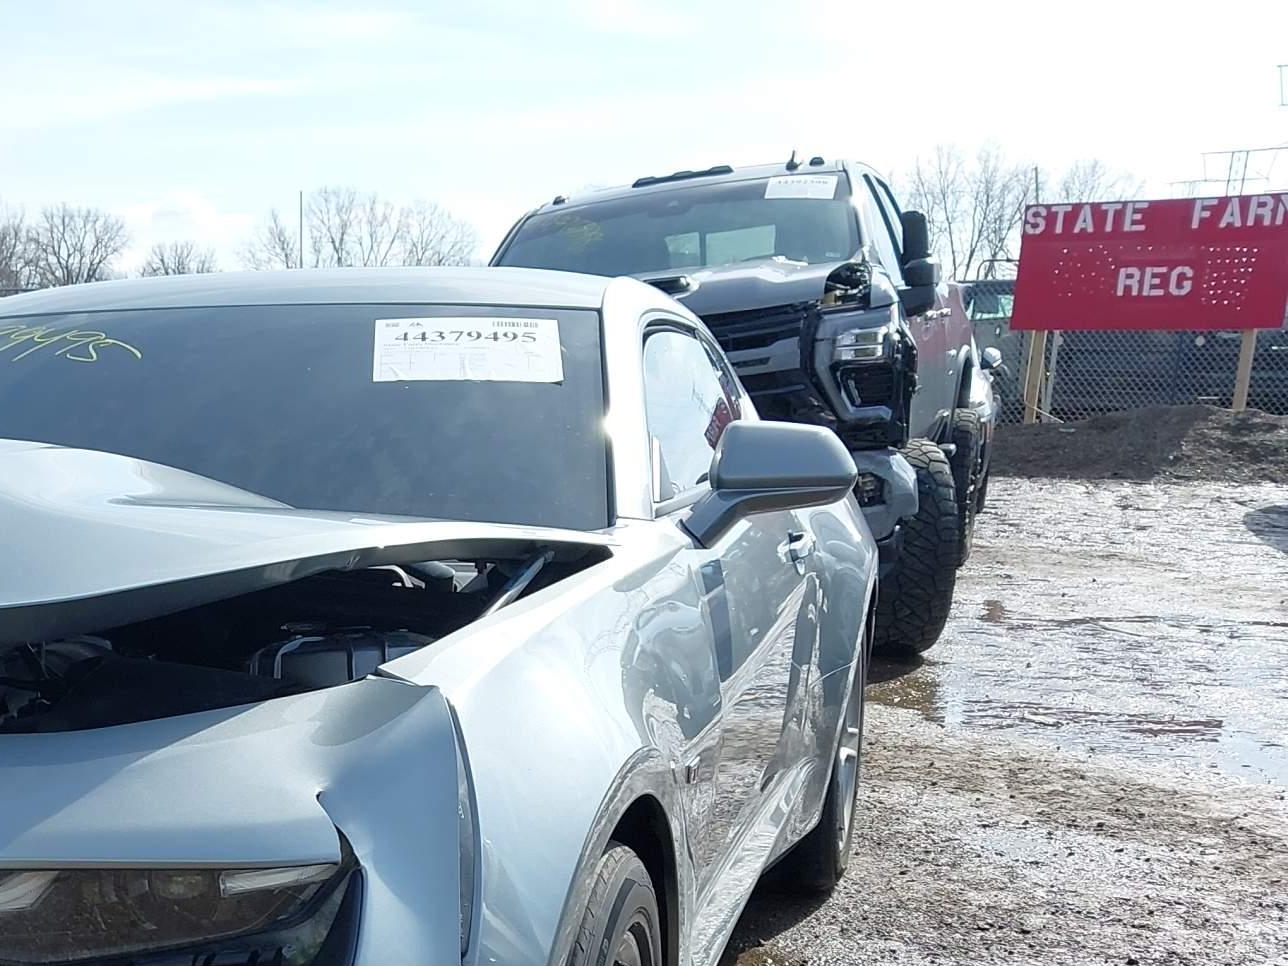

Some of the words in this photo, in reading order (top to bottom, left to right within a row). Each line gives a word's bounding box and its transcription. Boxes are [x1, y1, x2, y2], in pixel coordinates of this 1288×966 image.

[1024, 201, 1150, 235] STATE
[1115, 265, 1194, 297] REG
[394, 330, 538, 343] 44379495
